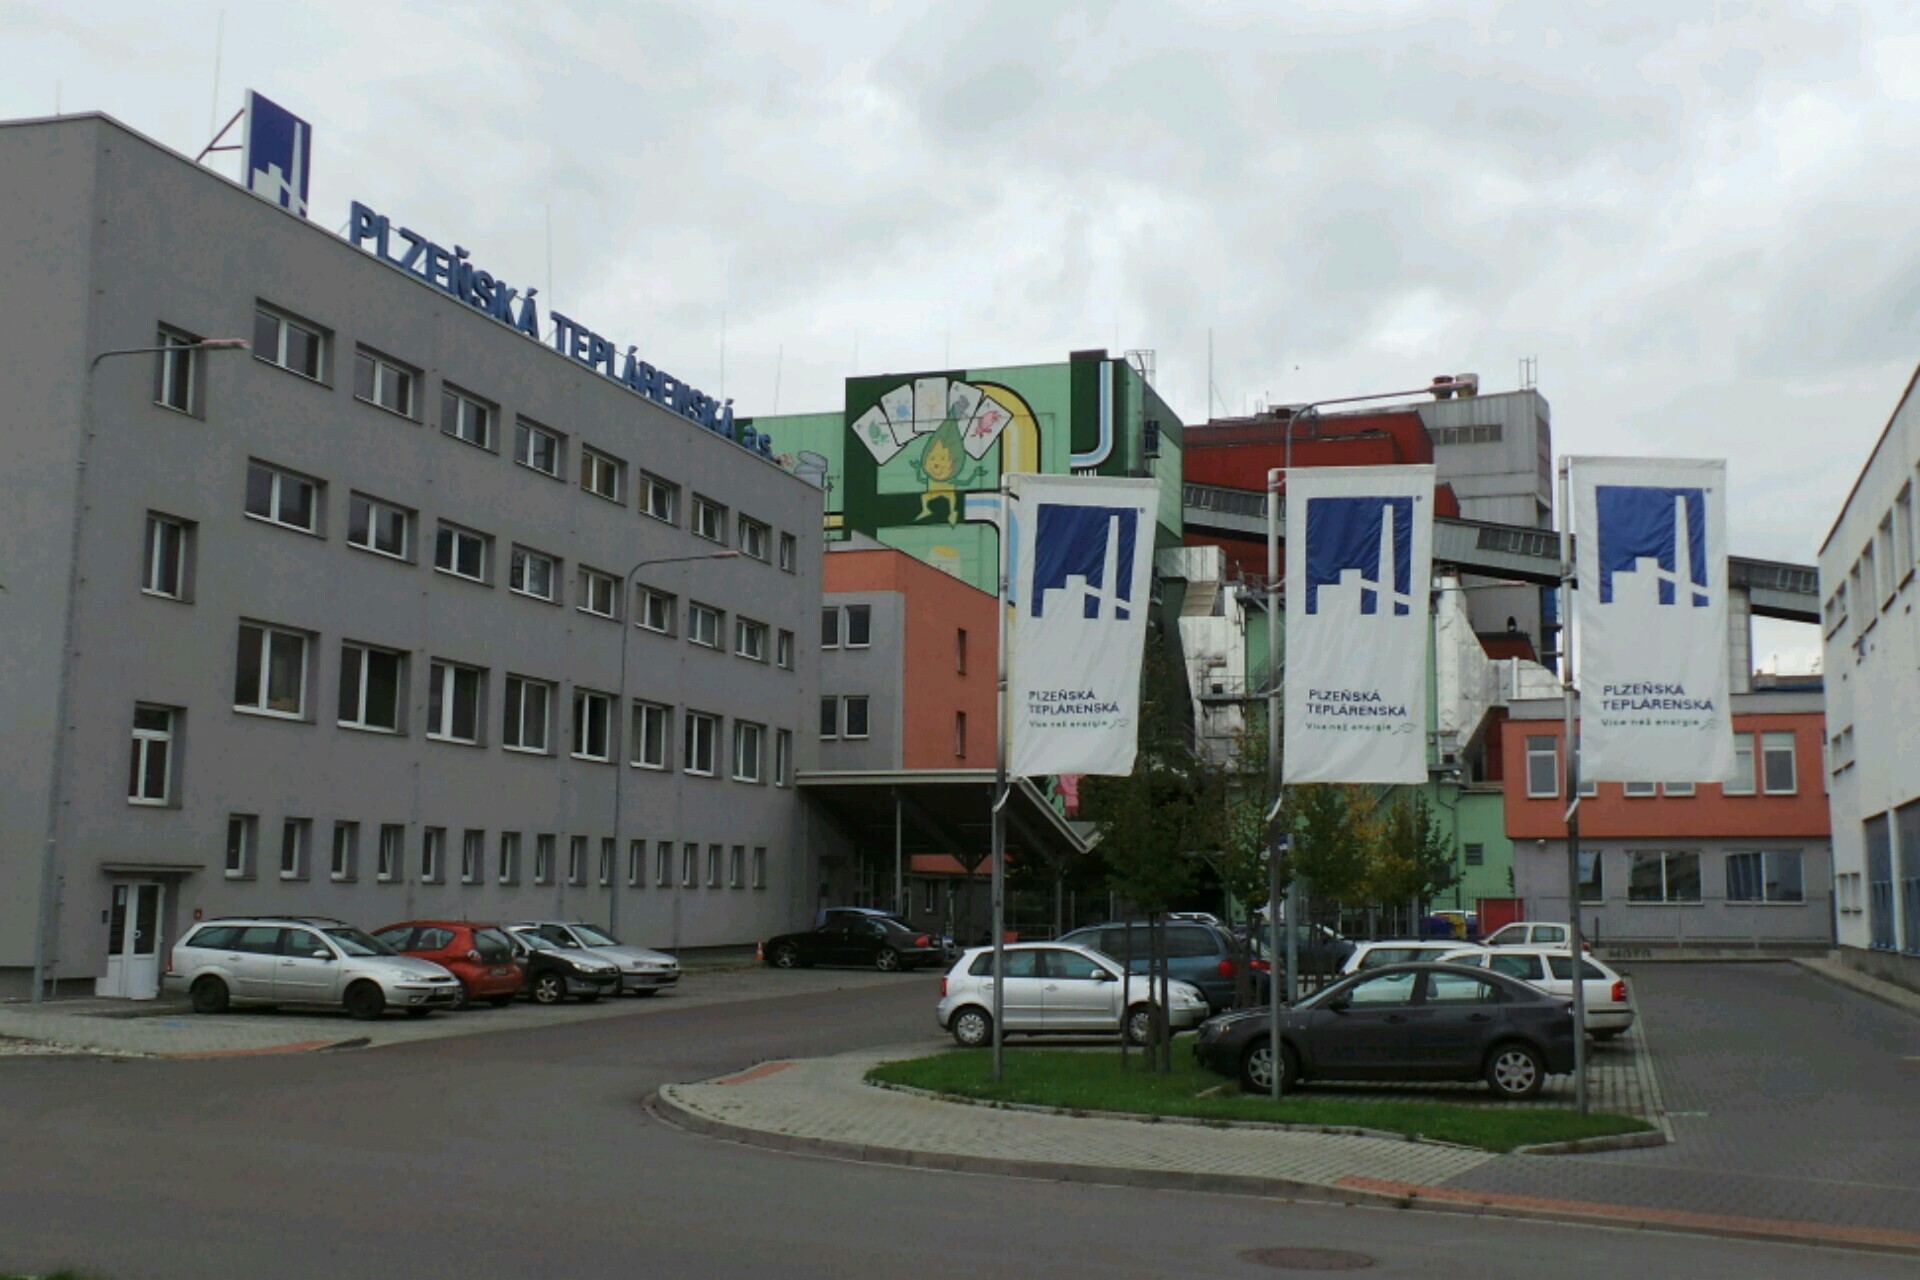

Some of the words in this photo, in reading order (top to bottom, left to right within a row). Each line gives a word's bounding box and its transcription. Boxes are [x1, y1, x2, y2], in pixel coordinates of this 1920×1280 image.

[349, 200, 540, 339] PLZEŇSKÁ
[549, 309, 736, 441] TEPLÁRENSKÁ
[1028, 687, 1096, 702] PLZEŇSKÁ
[1308, 688, 1381, 702] PLZEŇSKÁ
[1603, 681, 1685, 696] PLZEŇSKÁ
[1027, 701, 1120, 715] TEPLÁRENSKÁ
[1305, 702, 1407, 717] TEPLÁRENSKÁ
[1601, 697, 1714, 711] TEPLÁRENSKÁ
